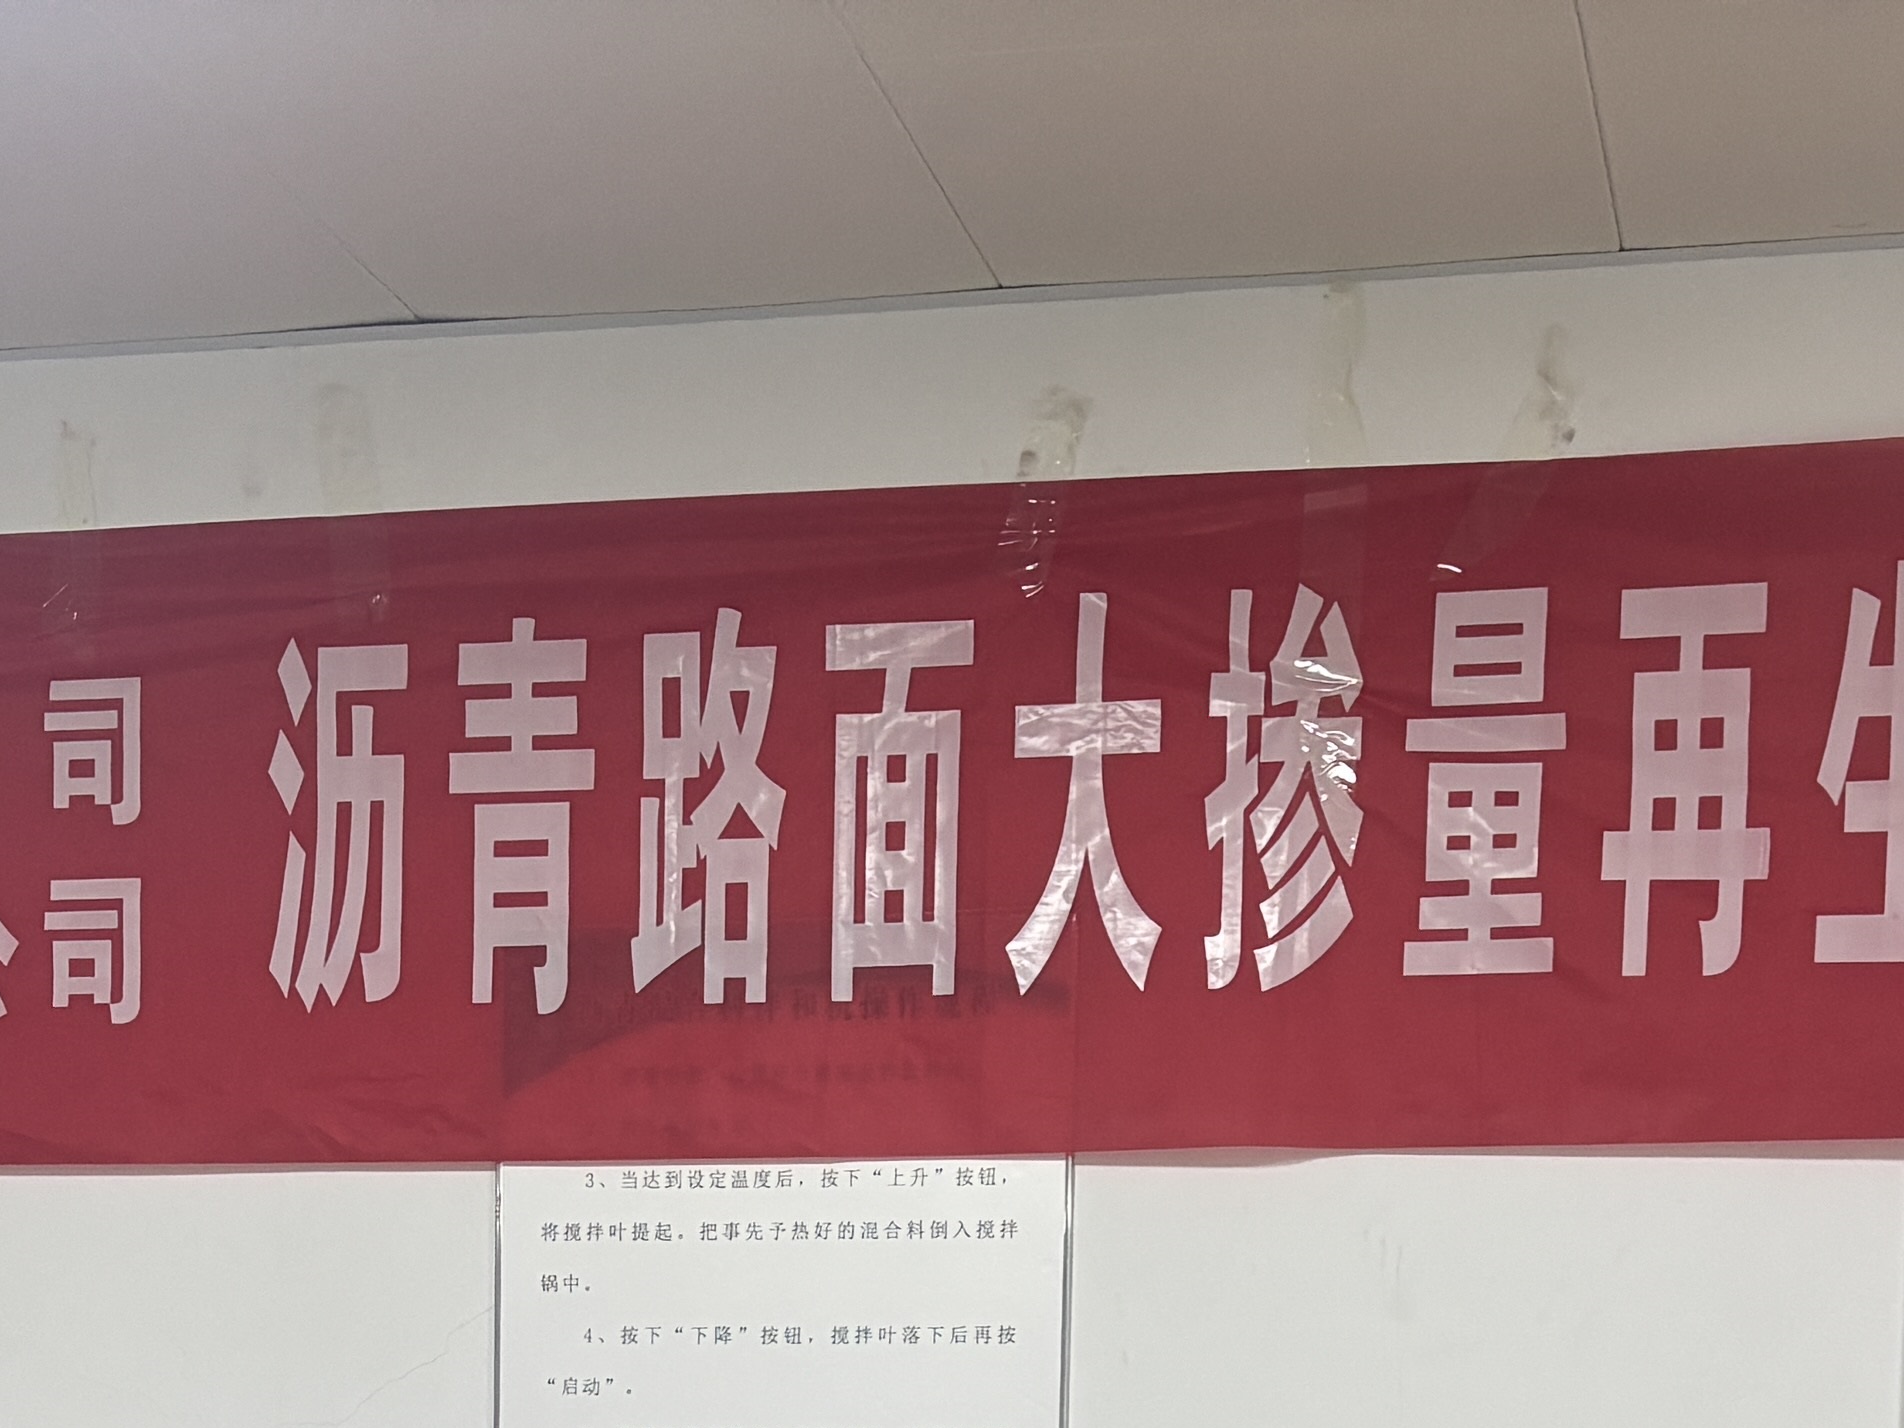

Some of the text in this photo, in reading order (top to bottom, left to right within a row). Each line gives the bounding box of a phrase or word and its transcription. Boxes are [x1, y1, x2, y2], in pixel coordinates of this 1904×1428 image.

[541, 1219, 1019, 1243] 将搅拌叶提起。把事先予热好的混合料倒入搅拌
[541, 1273, 591, 1294] 锅中。
